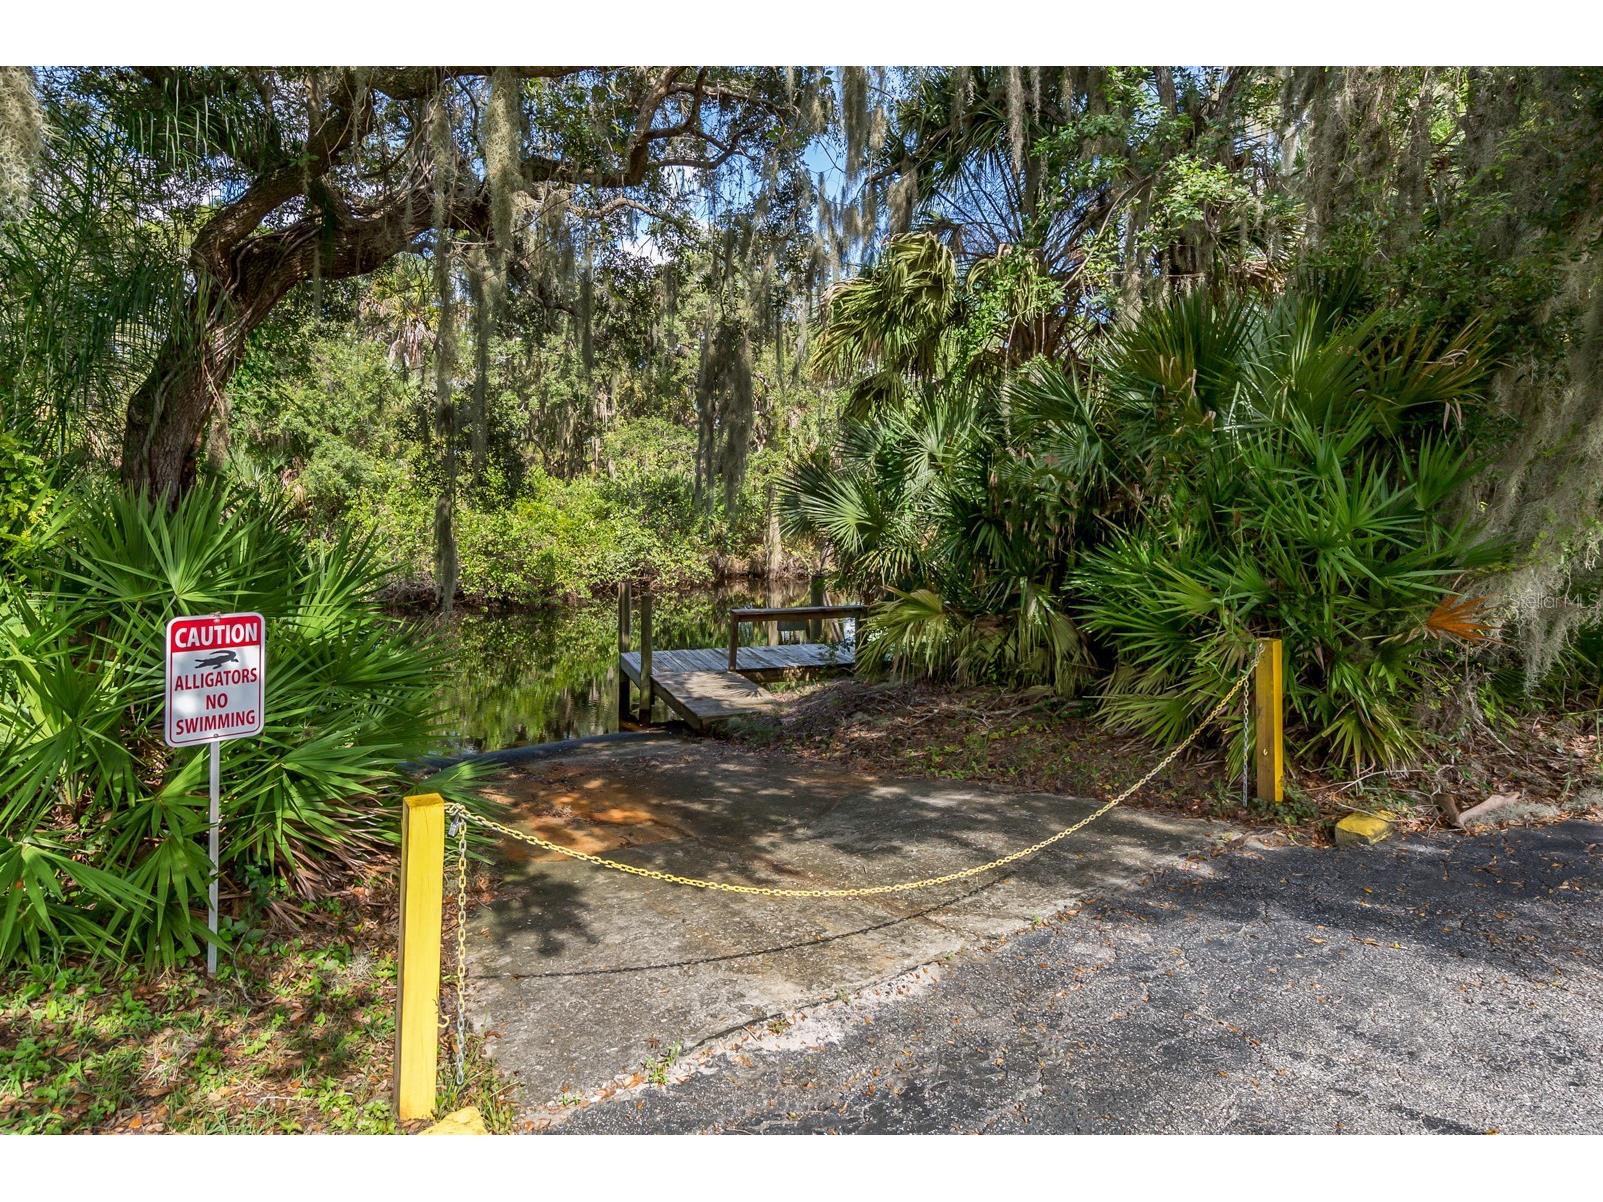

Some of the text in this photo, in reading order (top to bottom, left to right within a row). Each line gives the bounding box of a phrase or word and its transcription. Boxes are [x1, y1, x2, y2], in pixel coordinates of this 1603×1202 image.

[174, 622, 258, 648] CAUTION
[174, 667, 258, 691] ALLIGATORS
[205, 692, 228, 710] NO
[175, 709, 255, 735] SWIMMING
